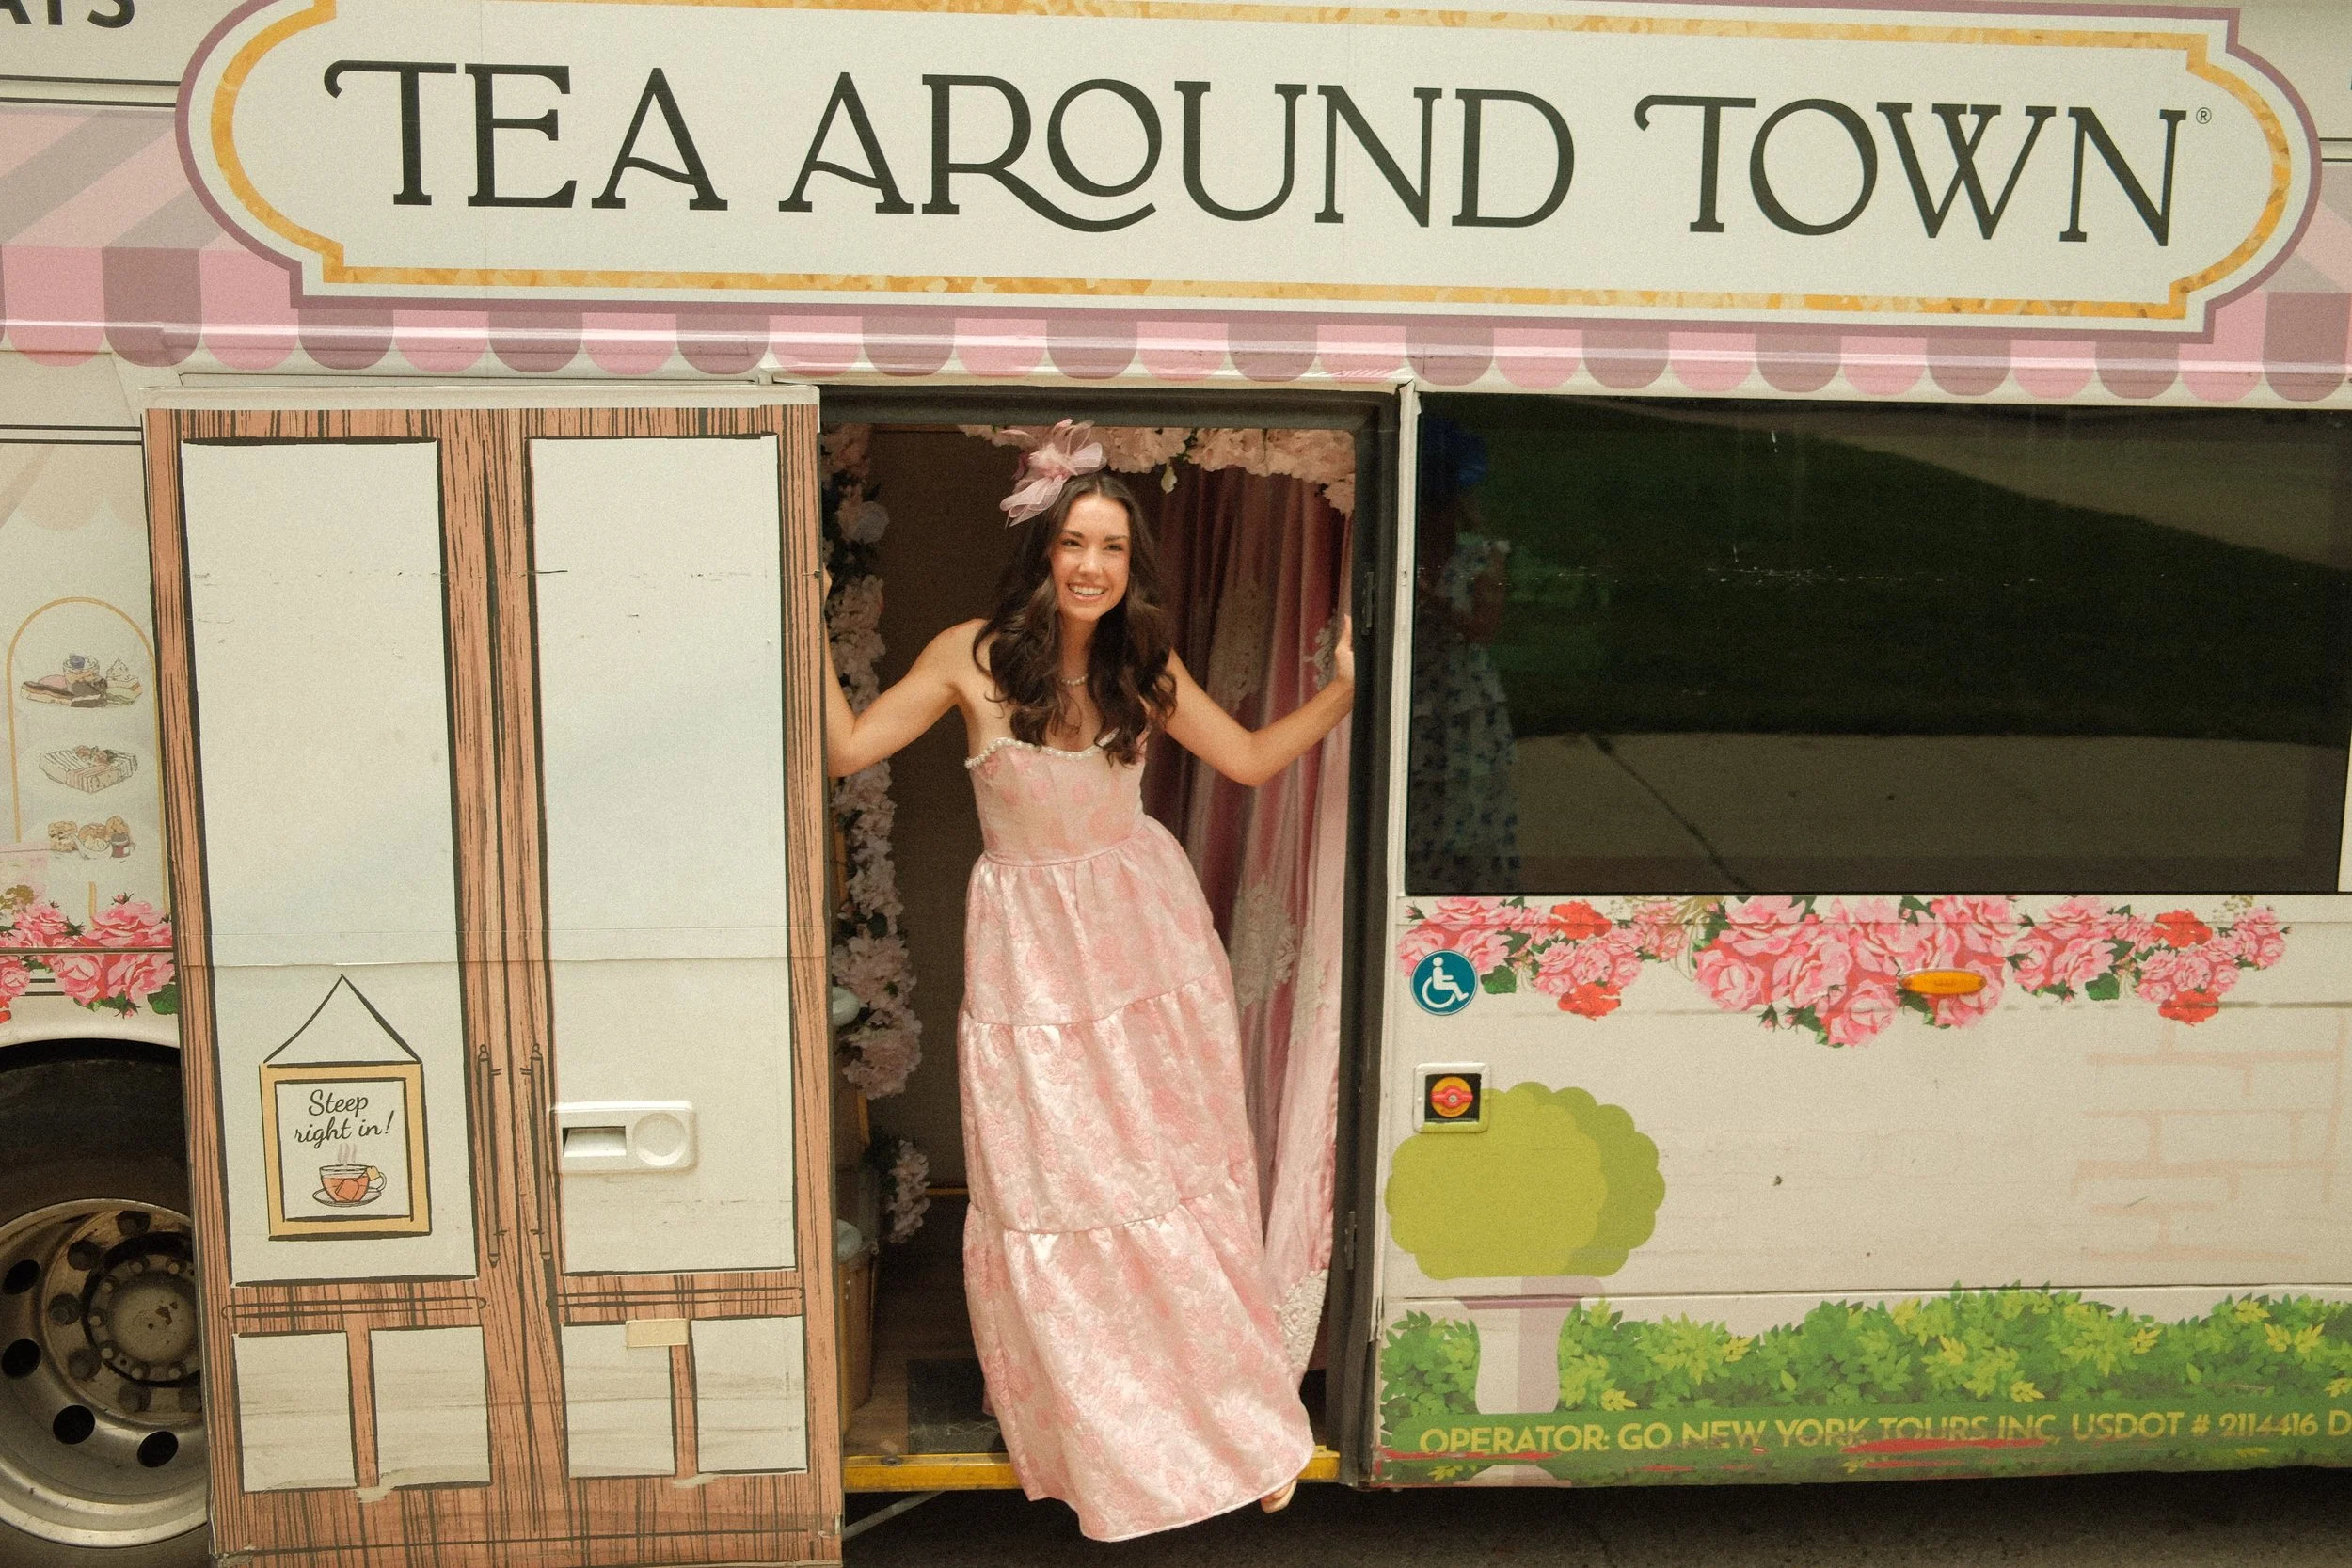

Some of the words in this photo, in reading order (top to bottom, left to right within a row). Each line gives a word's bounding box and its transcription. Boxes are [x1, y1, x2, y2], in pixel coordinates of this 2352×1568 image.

[324, 59, 728, 212] TEA
[778, 71, 1576, 233] AROUND
[308, 1089, 369, 1117] Steep
[294, 1116, 353, 1149] right
[358, 1110, 395, 1136] in!
[1419, 1424, 1610, 1455] OPERATOR:
[1617, 1422, 1673, 1451] GO
[1681, 1419, 1767, 1449] NEW
[1774, 1417, 1870, 1447] YORK
[1878, 1415, 1989, 1443] TOURS
[2072, 1411, 2185, 1441] USDOT
[2190, 1413, 2211, 1437] #
[2218, 1412, 2319, 1438] 2114416
